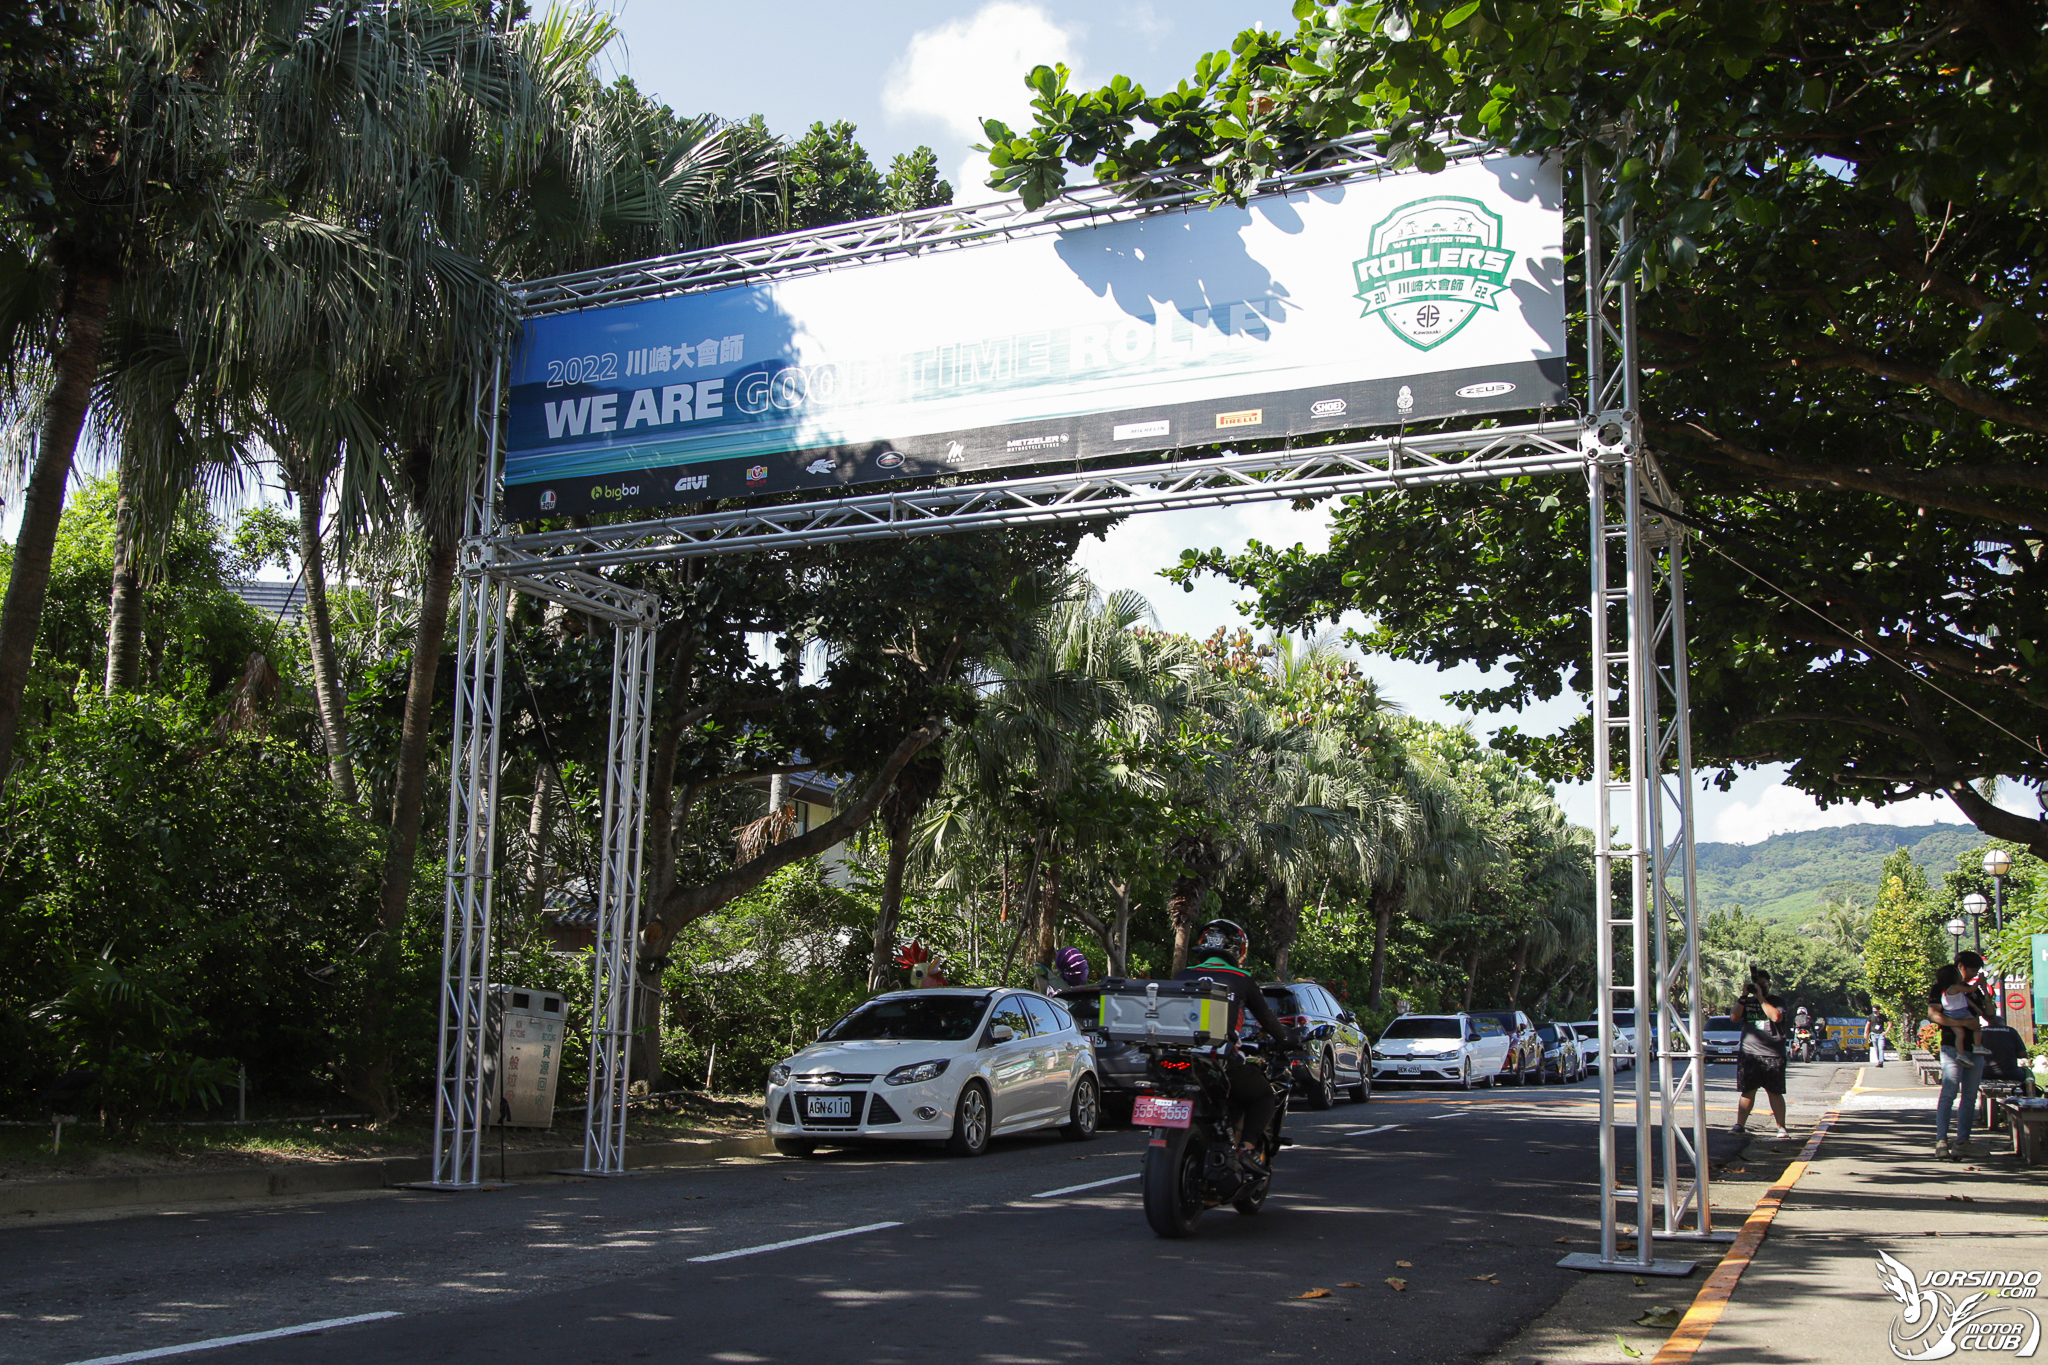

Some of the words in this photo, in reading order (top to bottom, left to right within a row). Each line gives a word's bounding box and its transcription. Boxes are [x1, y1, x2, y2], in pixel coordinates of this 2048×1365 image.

[1392, 240, 1408, 249] WE
[1409, 237, 1428, 246] ARE
[1429, 235, 1454, 244] GOOD
[1455, 235, 1478, 244] TIME
[1357, 247, 1510, 283] ROLLERS
[1398, 278, 1465, 294] 川崎大會師
[1474, 285, 1488, 299] 22
[1374, 291, 1387, 305] 20
[546, 353, 618, 388] 2022
[625, 334, 745, 377] 川崎大會師
[545, 393, 618, 439] WE
[623, 378, 724, 429] ARE
[896, 330, 1051, 391] TIME
[1466, 384, 1505, 394] ZEUS
[1315, 402, 1341, 412] SHOEI
[1219, 412, 1258, 425] PIRELLI
[1006, 436, 1060, 448] METZELER
[1006, 443, 1042, 453] MOTORCYCLE
[674, 475, 709, 491] GIVI
[604, 482, 640, 501] bigboi
[1846, 1037, 1866, 1045] LOBBY
[809, 1101, 850, 1114] AGN-6110
